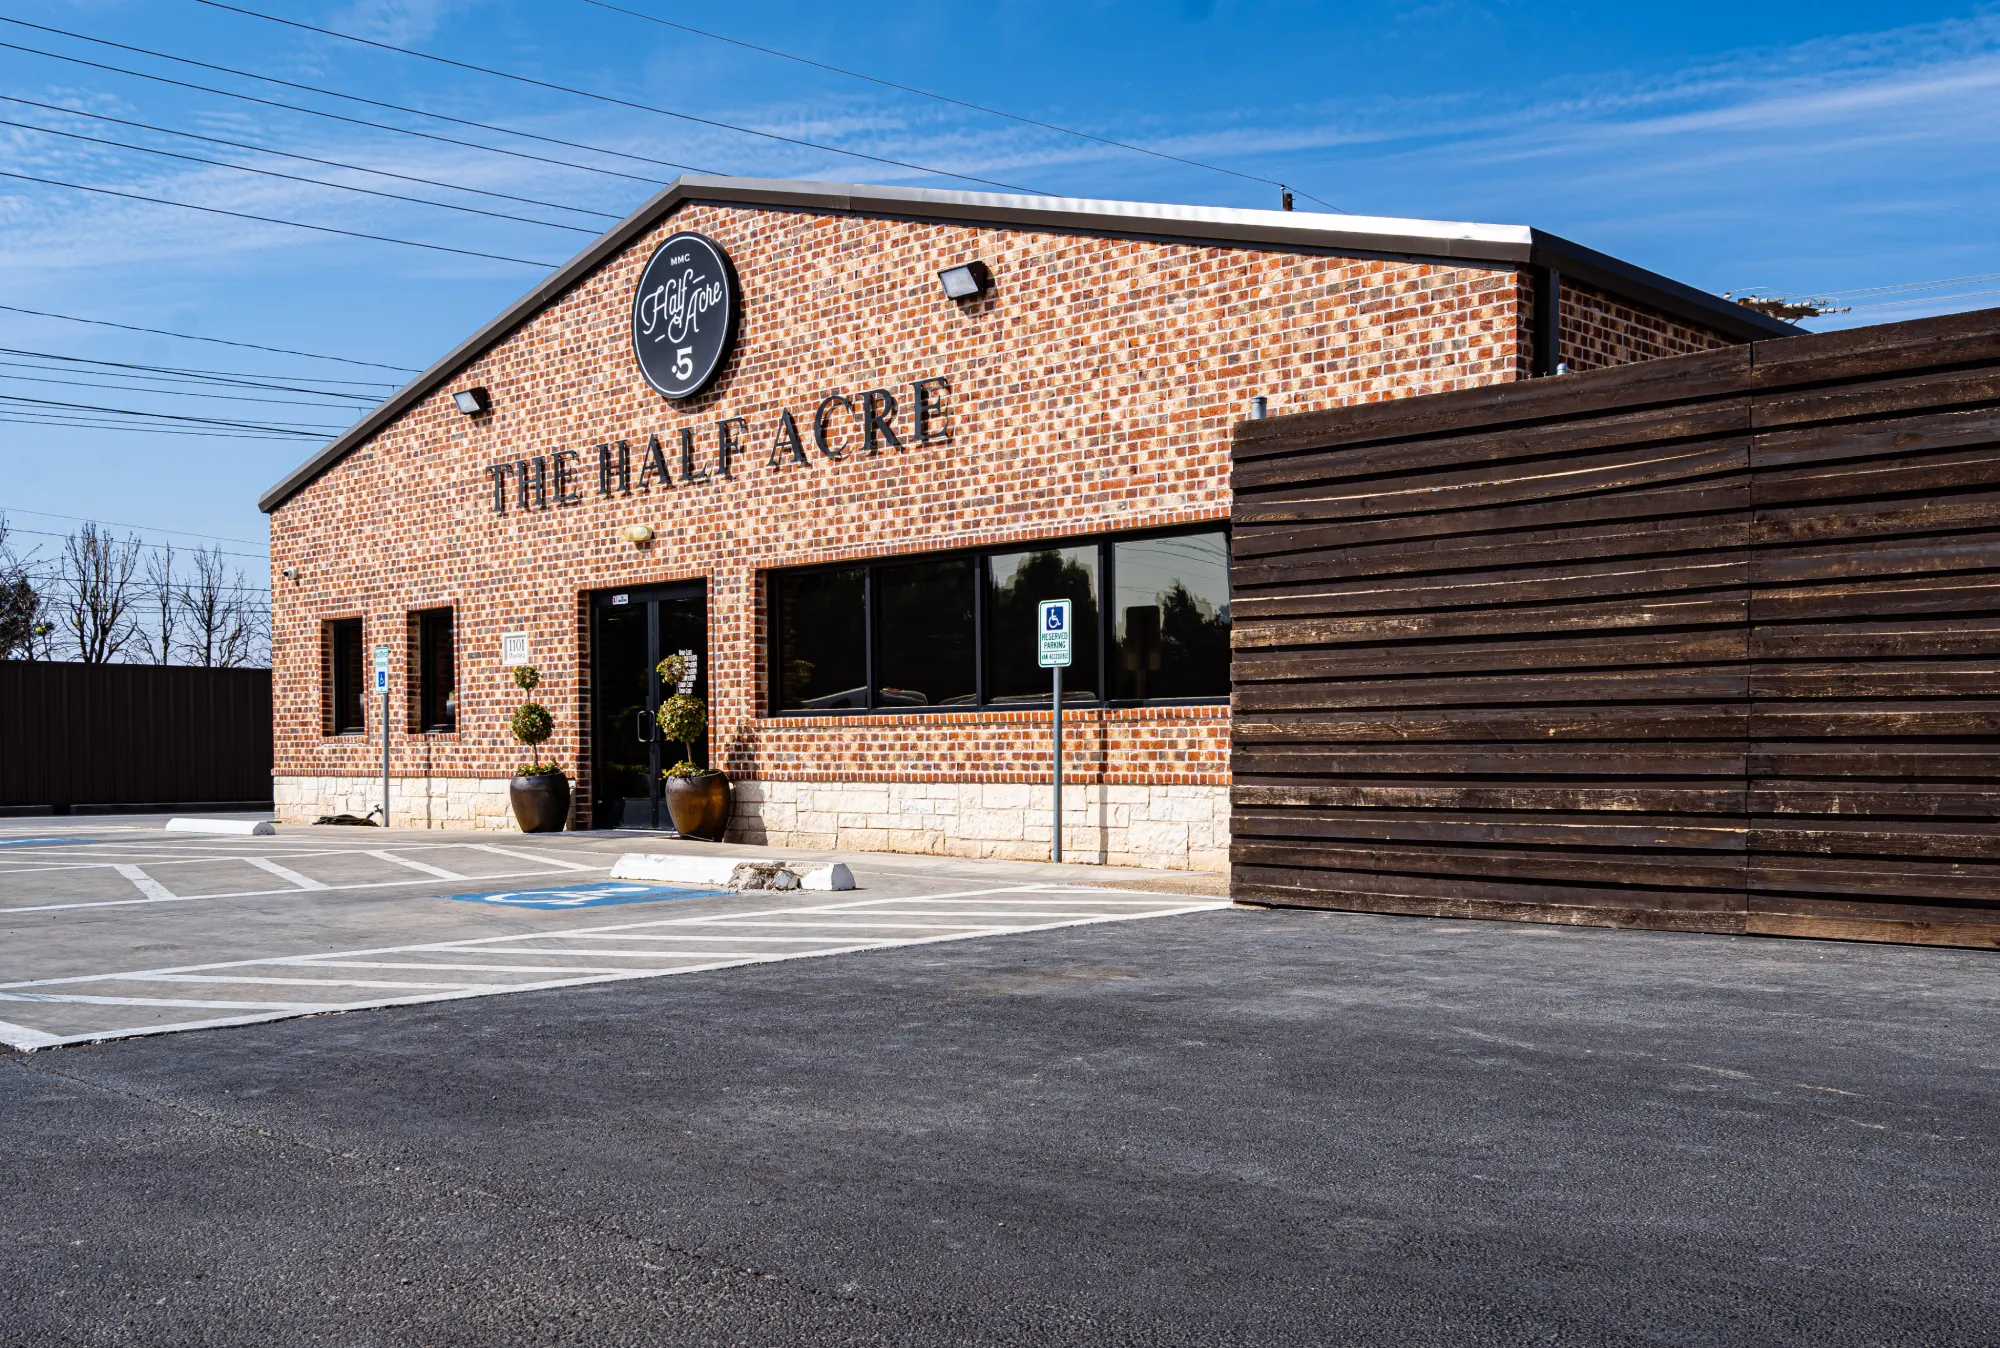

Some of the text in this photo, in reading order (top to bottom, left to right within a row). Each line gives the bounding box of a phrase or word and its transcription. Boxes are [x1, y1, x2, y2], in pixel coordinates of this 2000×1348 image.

[670, 253, 691, 266] MMC
[641, 268, 694, 335] Half
[667, 281, 723, 344] Acre
[671, 345, 693, 381] .5
[485, 375, 950, 513] THE HALF ACRE
[509, 639, 524, 651] 1101
[1042, 632, 1068, 641] RESERVED
[1044, 641, 1066, 649] PARKING
